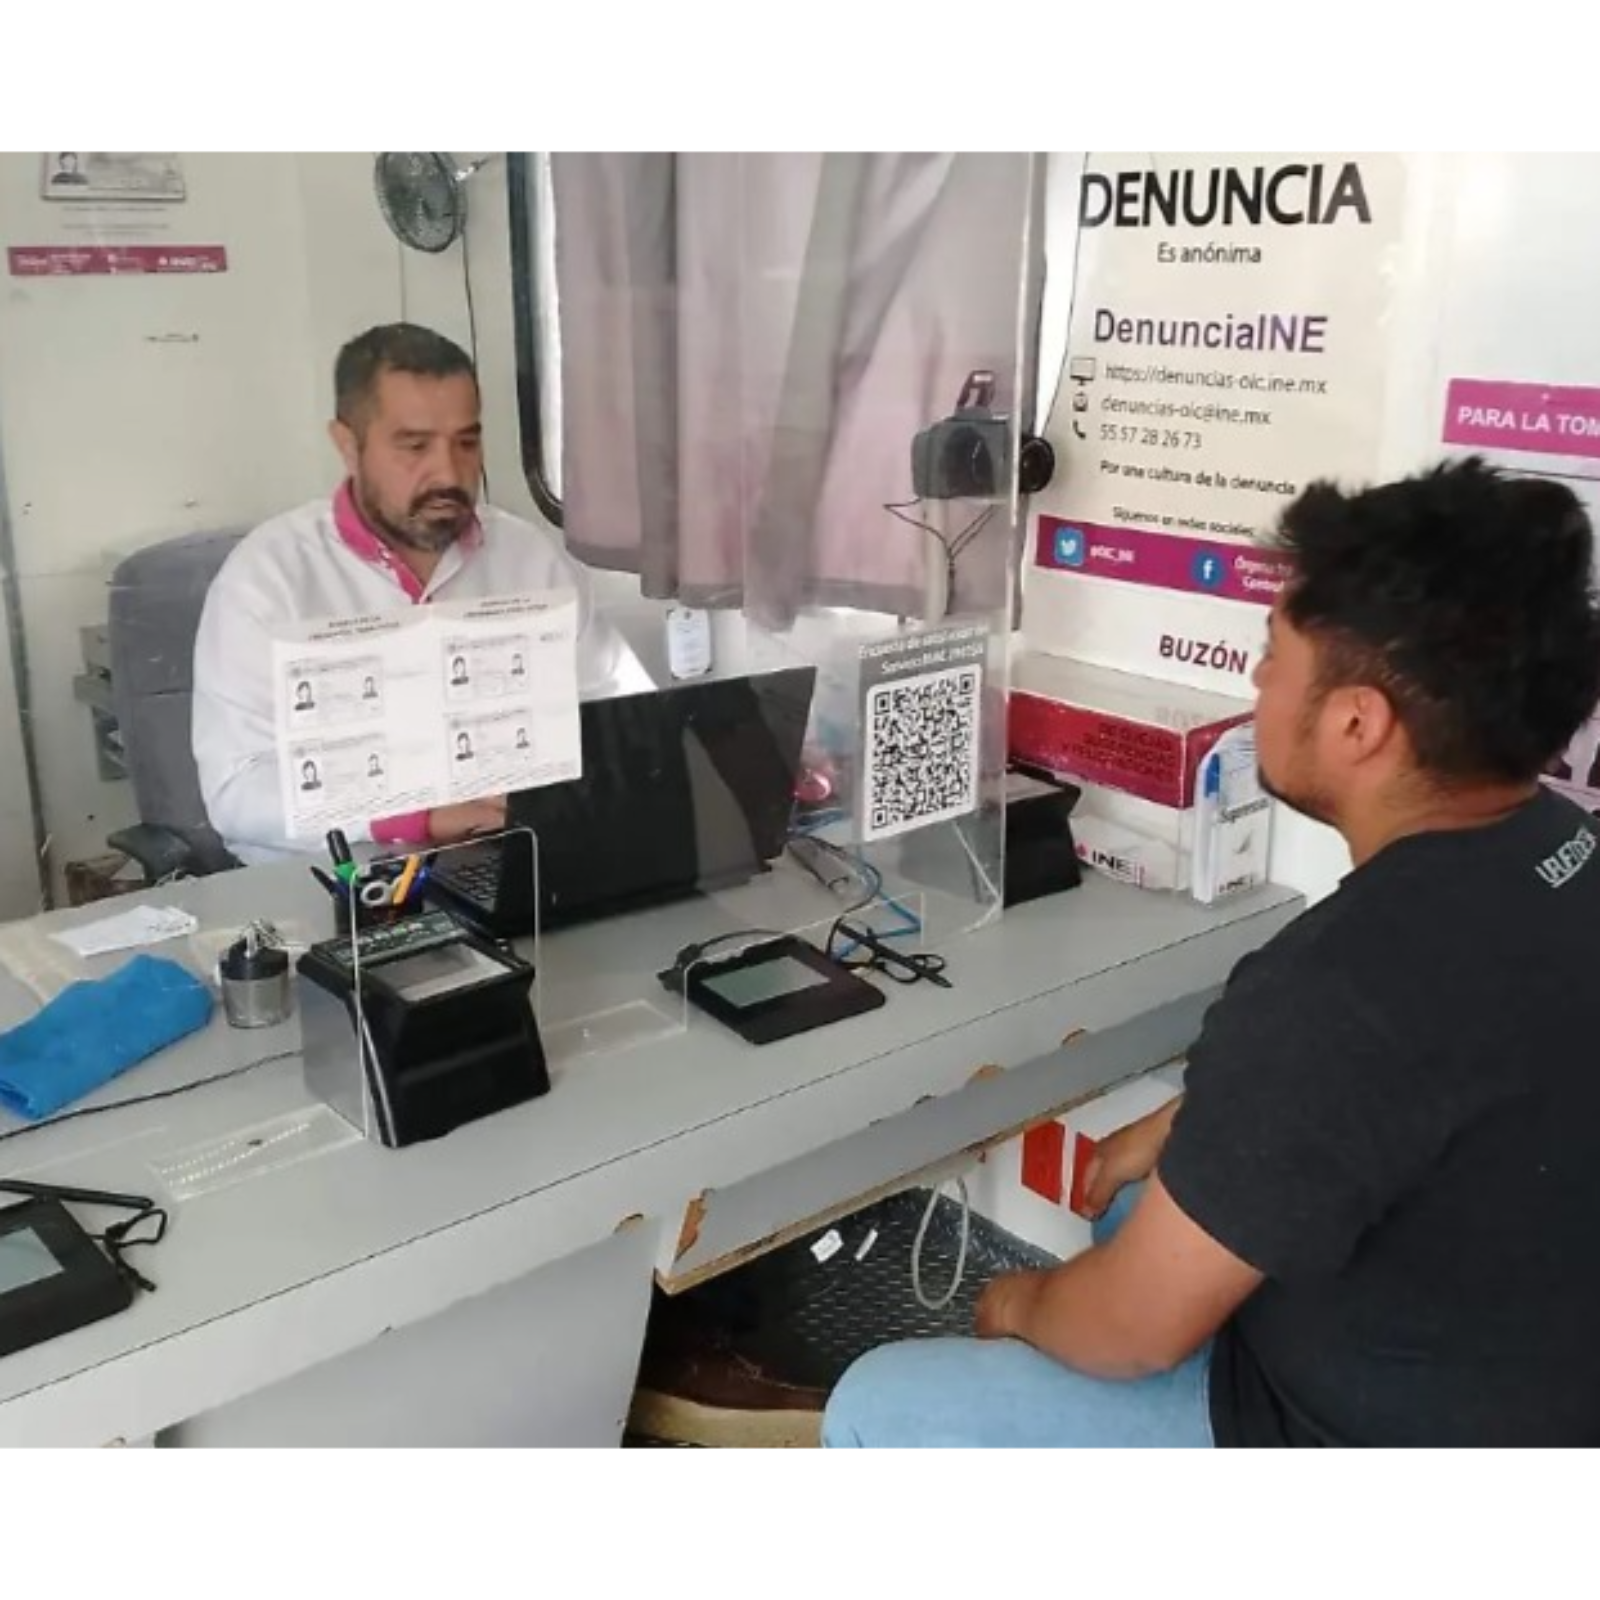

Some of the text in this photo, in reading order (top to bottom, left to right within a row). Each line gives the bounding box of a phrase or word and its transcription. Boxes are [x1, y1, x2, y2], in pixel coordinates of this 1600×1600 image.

[1079, 162, 1372, 227] DENUNCIA
[1158, 242, 1262, 263] Es anónima
[1095, 308, 1328, 353] DenunciaINE
[1457, 406, 1516, 429] PARA
[1521, 412, 1551, 433] LA
[1100, 423, 1203, 450] 55 57 28 26 73
[1100, 459, 1120, 475] Por
[1149, 466, 1192, 484] cultura
[1196, 470, 1213, 487] de
[1215, 472, 1228, 488] la
[1159, 634, 1248, 675] BUZÓN
[1092, 848, 1131, 872] INE
